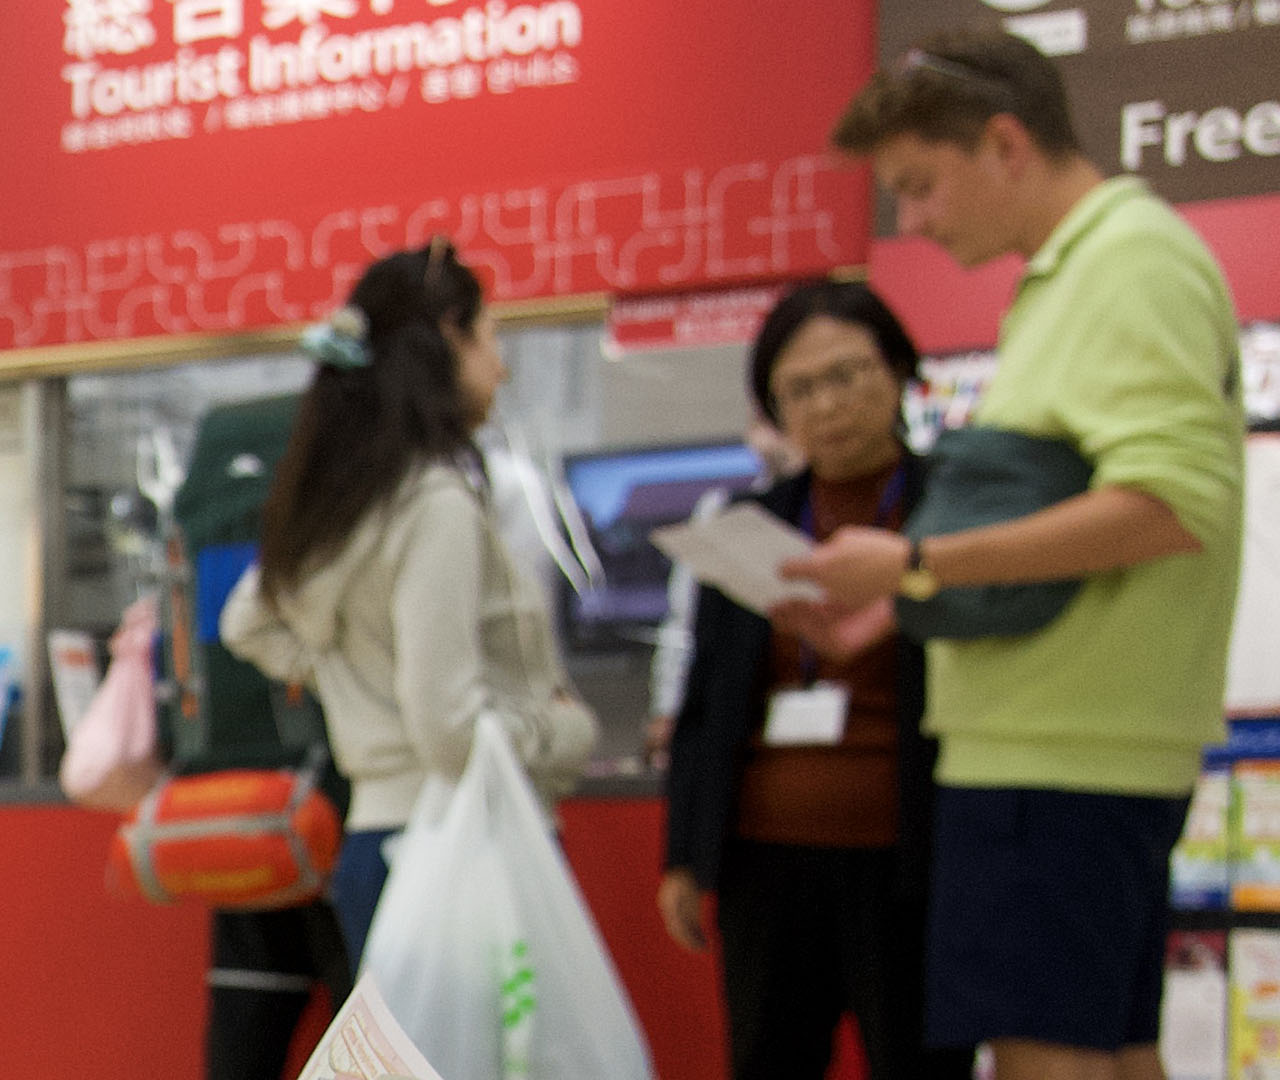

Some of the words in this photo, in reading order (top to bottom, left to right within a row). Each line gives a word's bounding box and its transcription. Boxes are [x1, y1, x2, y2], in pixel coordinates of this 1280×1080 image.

[61, 46, 244, 120] Tourist
[249, 0, 582, 93] Information
[1120, 100, 1280, 171] Free
